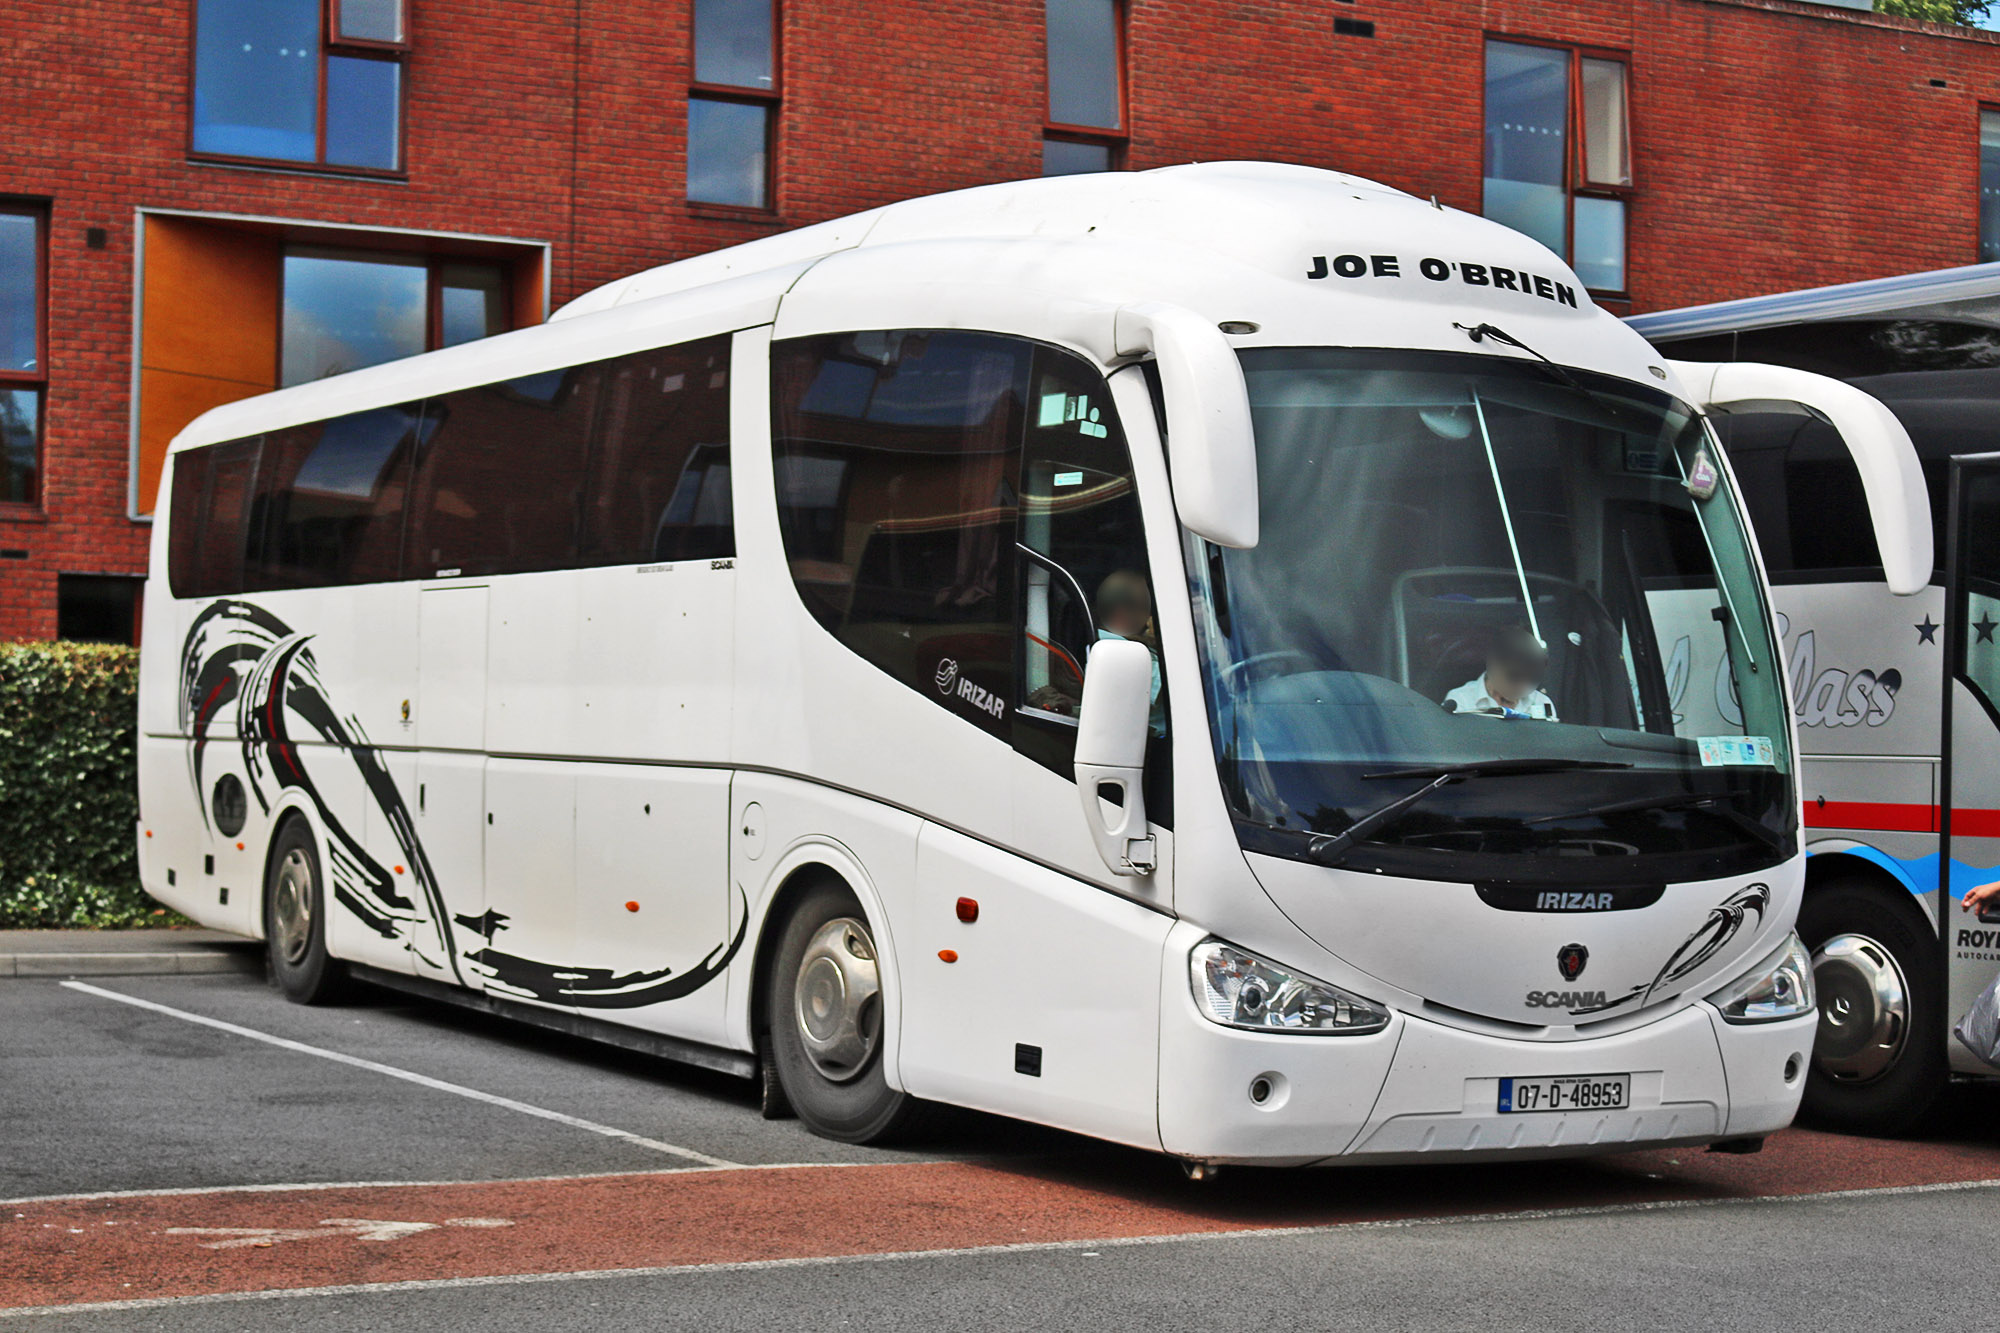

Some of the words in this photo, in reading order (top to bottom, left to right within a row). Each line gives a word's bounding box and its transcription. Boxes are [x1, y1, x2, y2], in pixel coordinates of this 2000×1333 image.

[1307, 254, 1401, 280] JOE
[1420, 257, 1578, 310] O'BRIEN
[957, 677, 1005, 720] IRIZAR
[1536, 892, 1614, 910] IRIZAR
[1525, 990, 1608, 1009] SCANIA
[1518, 1082, 1623, 1109] 07-D-48953
